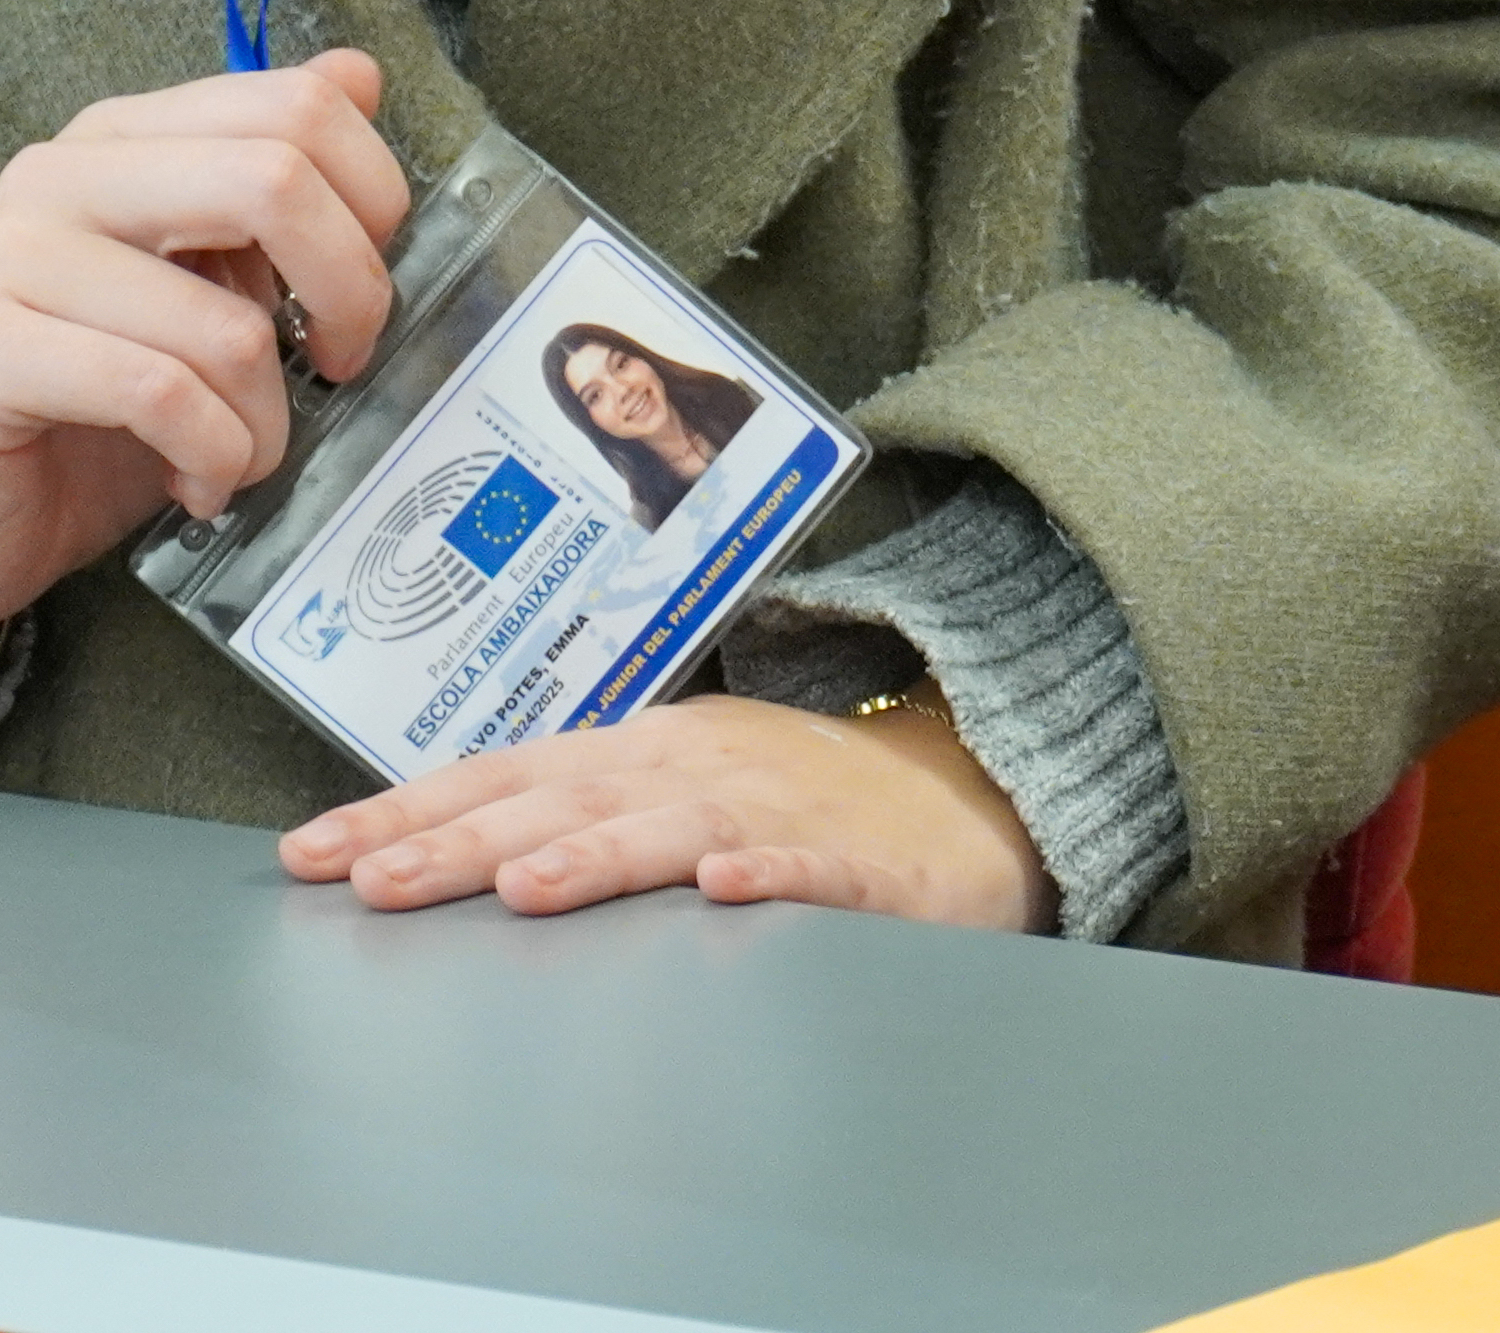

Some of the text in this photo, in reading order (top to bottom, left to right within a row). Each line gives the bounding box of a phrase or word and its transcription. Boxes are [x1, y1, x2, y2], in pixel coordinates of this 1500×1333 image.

[406, 518, 607, 749] ESCOLA AMBAIXADORA
[427, 513, 575, 681] Parlament Europeu
[495, 666, 549, 722] POTES,
[545, 614, 590, 663] EMMA
[599, 653, 647, 711] JÚNIOR
[643, 627, 672, 655] DEL
[668, 537, 743, 626] PARLAMENT
[742, 468, 802, 540] EUROPEU
[505, 677, 564, 745] 2024/2025
